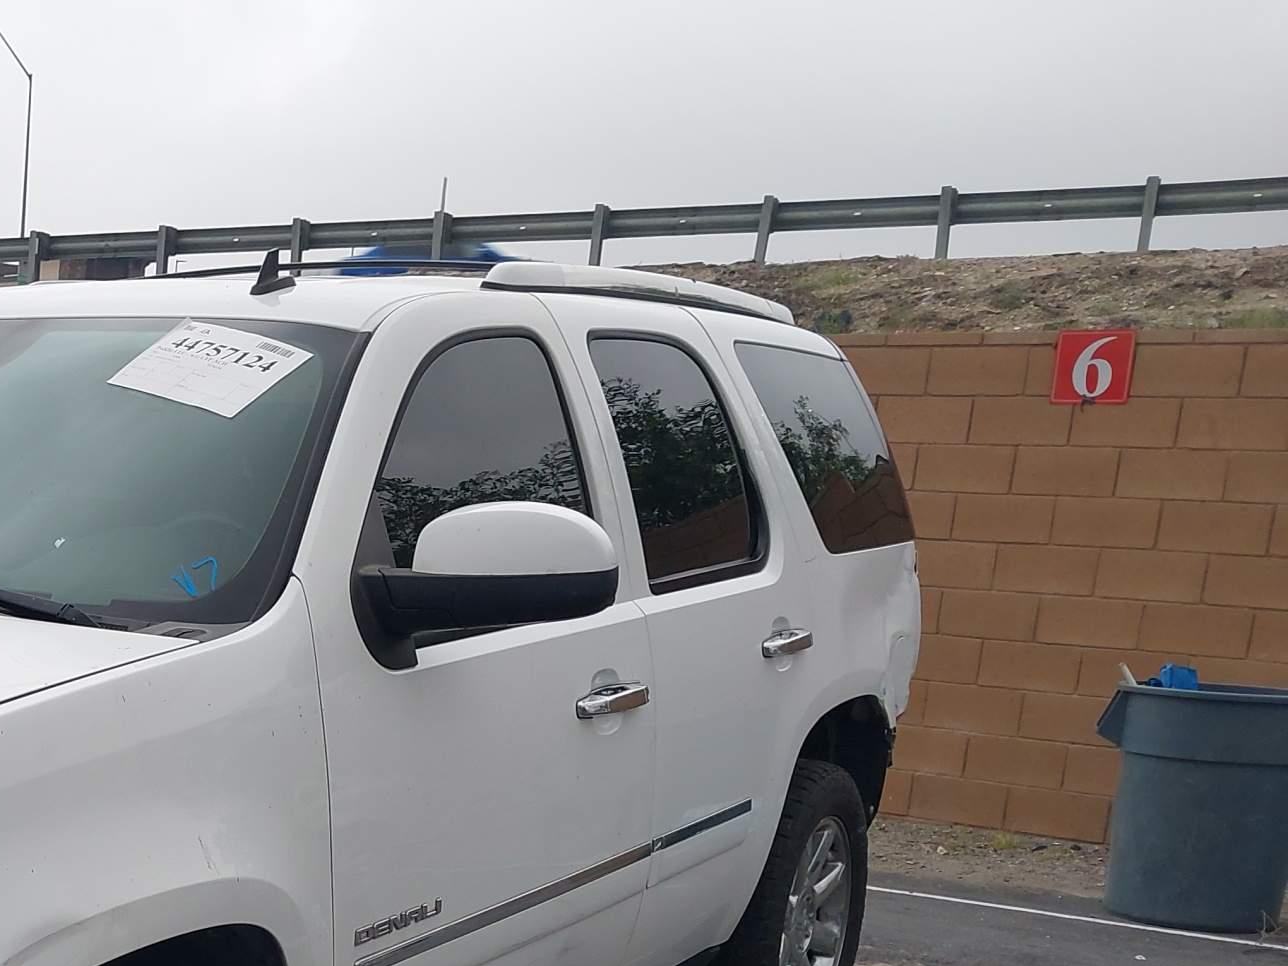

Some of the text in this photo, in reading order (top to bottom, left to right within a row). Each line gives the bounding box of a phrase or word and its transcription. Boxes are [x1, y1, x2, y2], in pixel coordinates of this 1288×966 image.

[171, 336, 279, 374] 44757124
[1072, 336, 1118, 398] 6
[354, 897, 442, 947] DENALI
